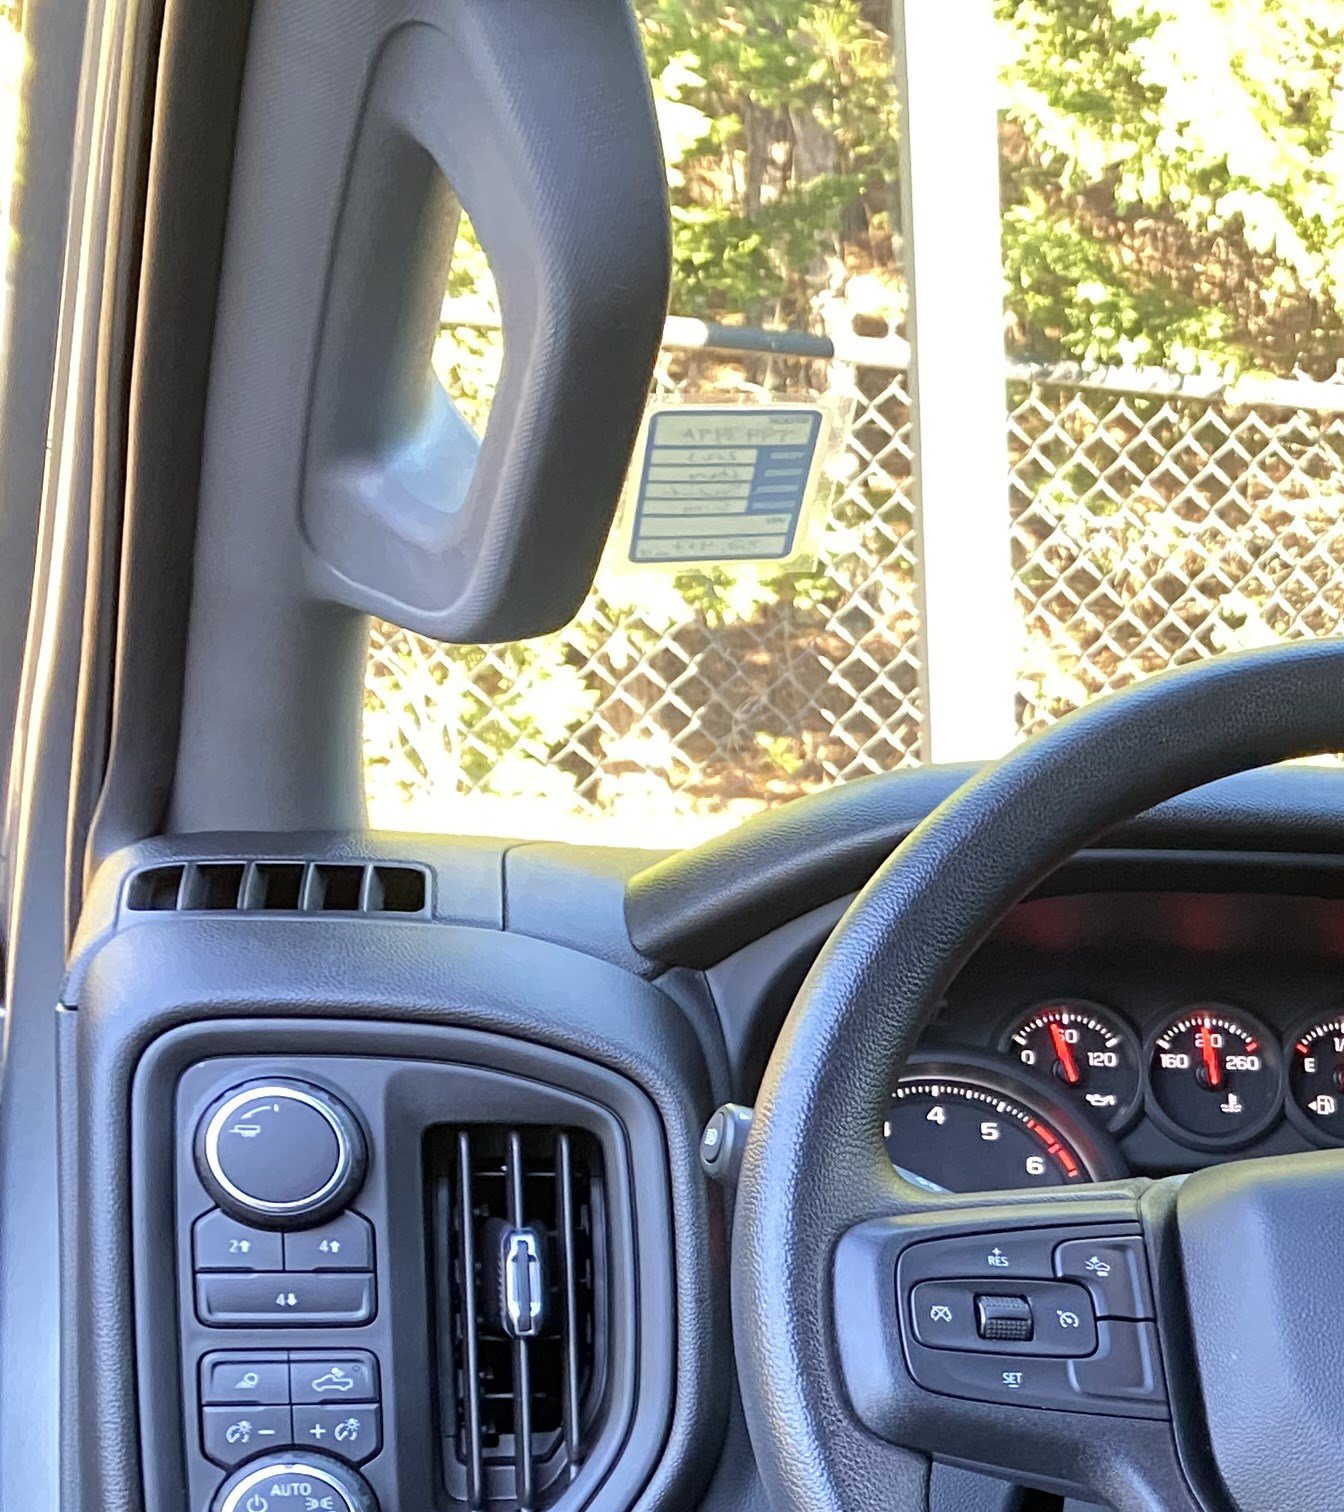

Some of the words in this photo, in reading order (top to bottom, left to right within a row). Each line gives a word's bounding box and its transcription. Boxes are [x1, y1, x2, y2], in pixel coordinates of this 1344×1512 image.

[1194, 1033, 1224, 1049] 20
[1020, 1049, 1036, 1066] 0
[1087, 1051, 1118, 1067] 120
[1160, 1053, 1189, 1069] 160
[1225, 1055, 1260, 1071] 260
[1303, 1057, 1316, 1073] E
[926, 1105, 946, 1126] 4
[980, 1122, 999, 1141] 5
[1026, 1156, 1045, 1175] 6
[988, 1254, 1009, 1268] RES
[1002, 1372, 1023, 1385] SET
[270, 1482, 312, 1498] AUTO
